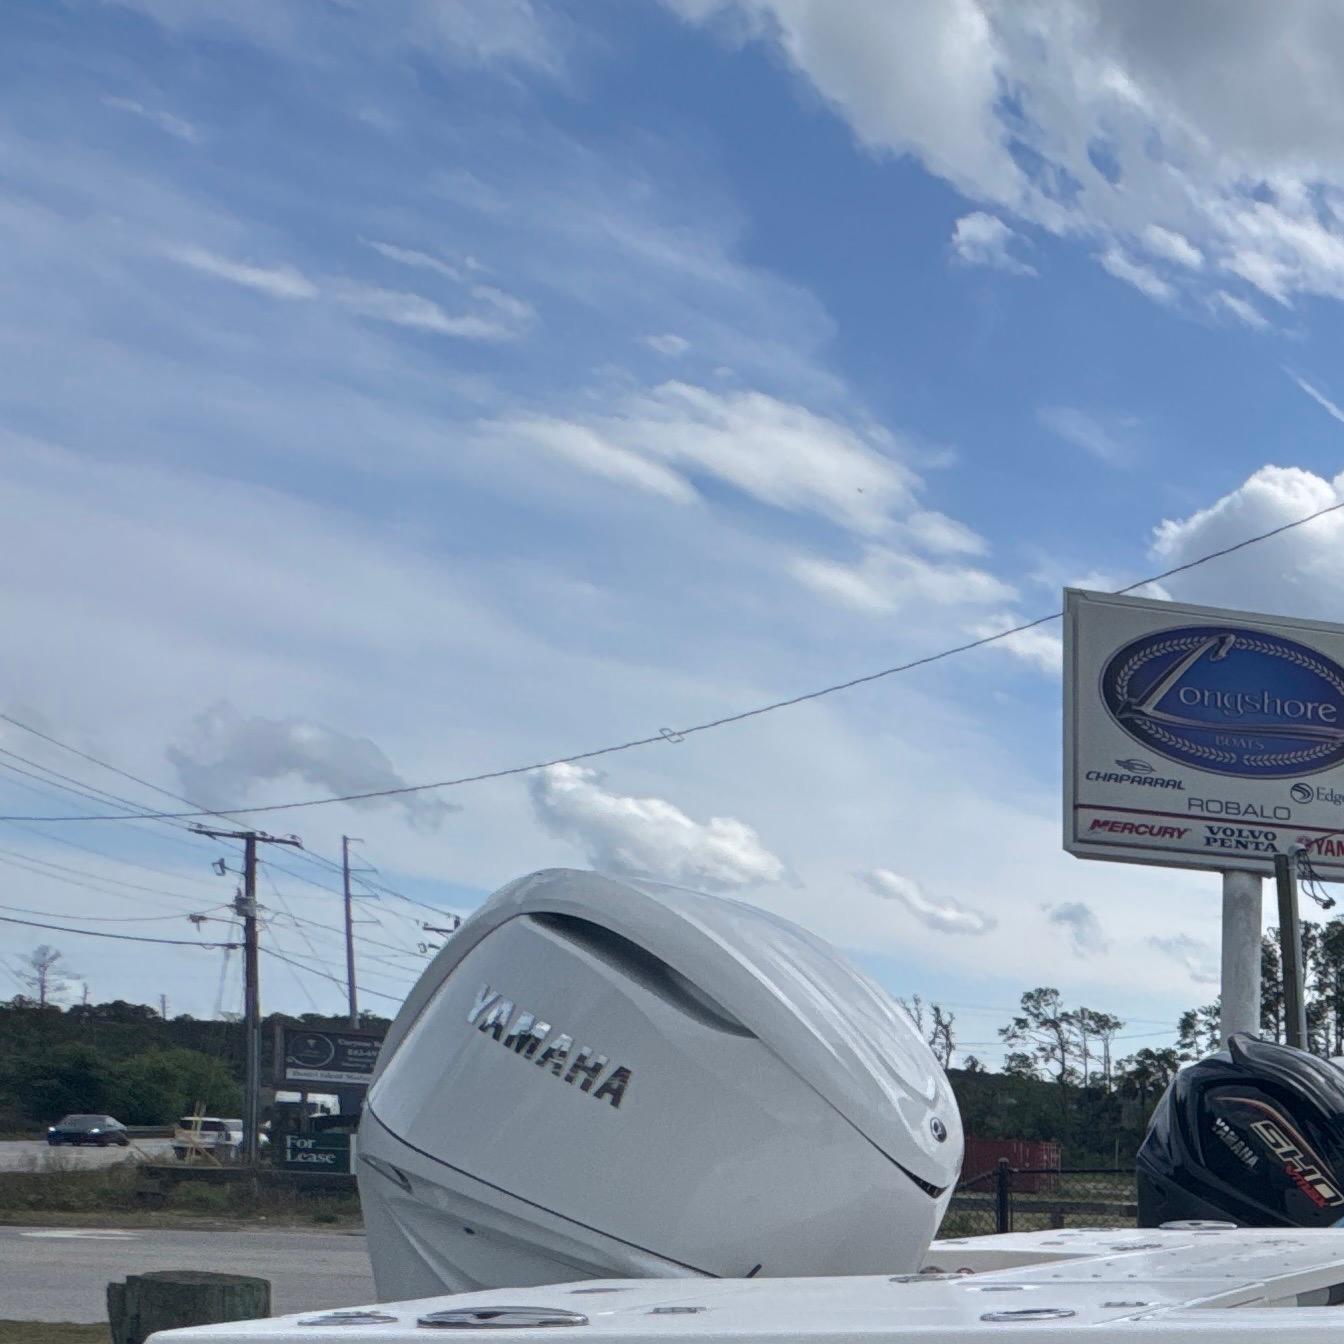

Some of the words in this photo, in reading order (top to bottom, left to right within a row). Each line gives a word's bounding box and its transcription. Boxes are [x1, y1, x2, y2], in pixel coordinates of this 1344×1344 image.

[1086, 770, 1186, 790] CHAPARRAL
[1187, 797, 1291, 821] ROBALO
[1089, 818, 1190, 840] MERCURY
[1204, 825, 1277, 842] VOLVO
[1204, 836, 1280, 852] PENTA
[467, 982, 632, 1110] YAMAHA
[285, 1135, 317, 1149] For
[1212, 1117, 1259, 1168] YAMAHA
[285, 1148, 337, 1165] Lease
